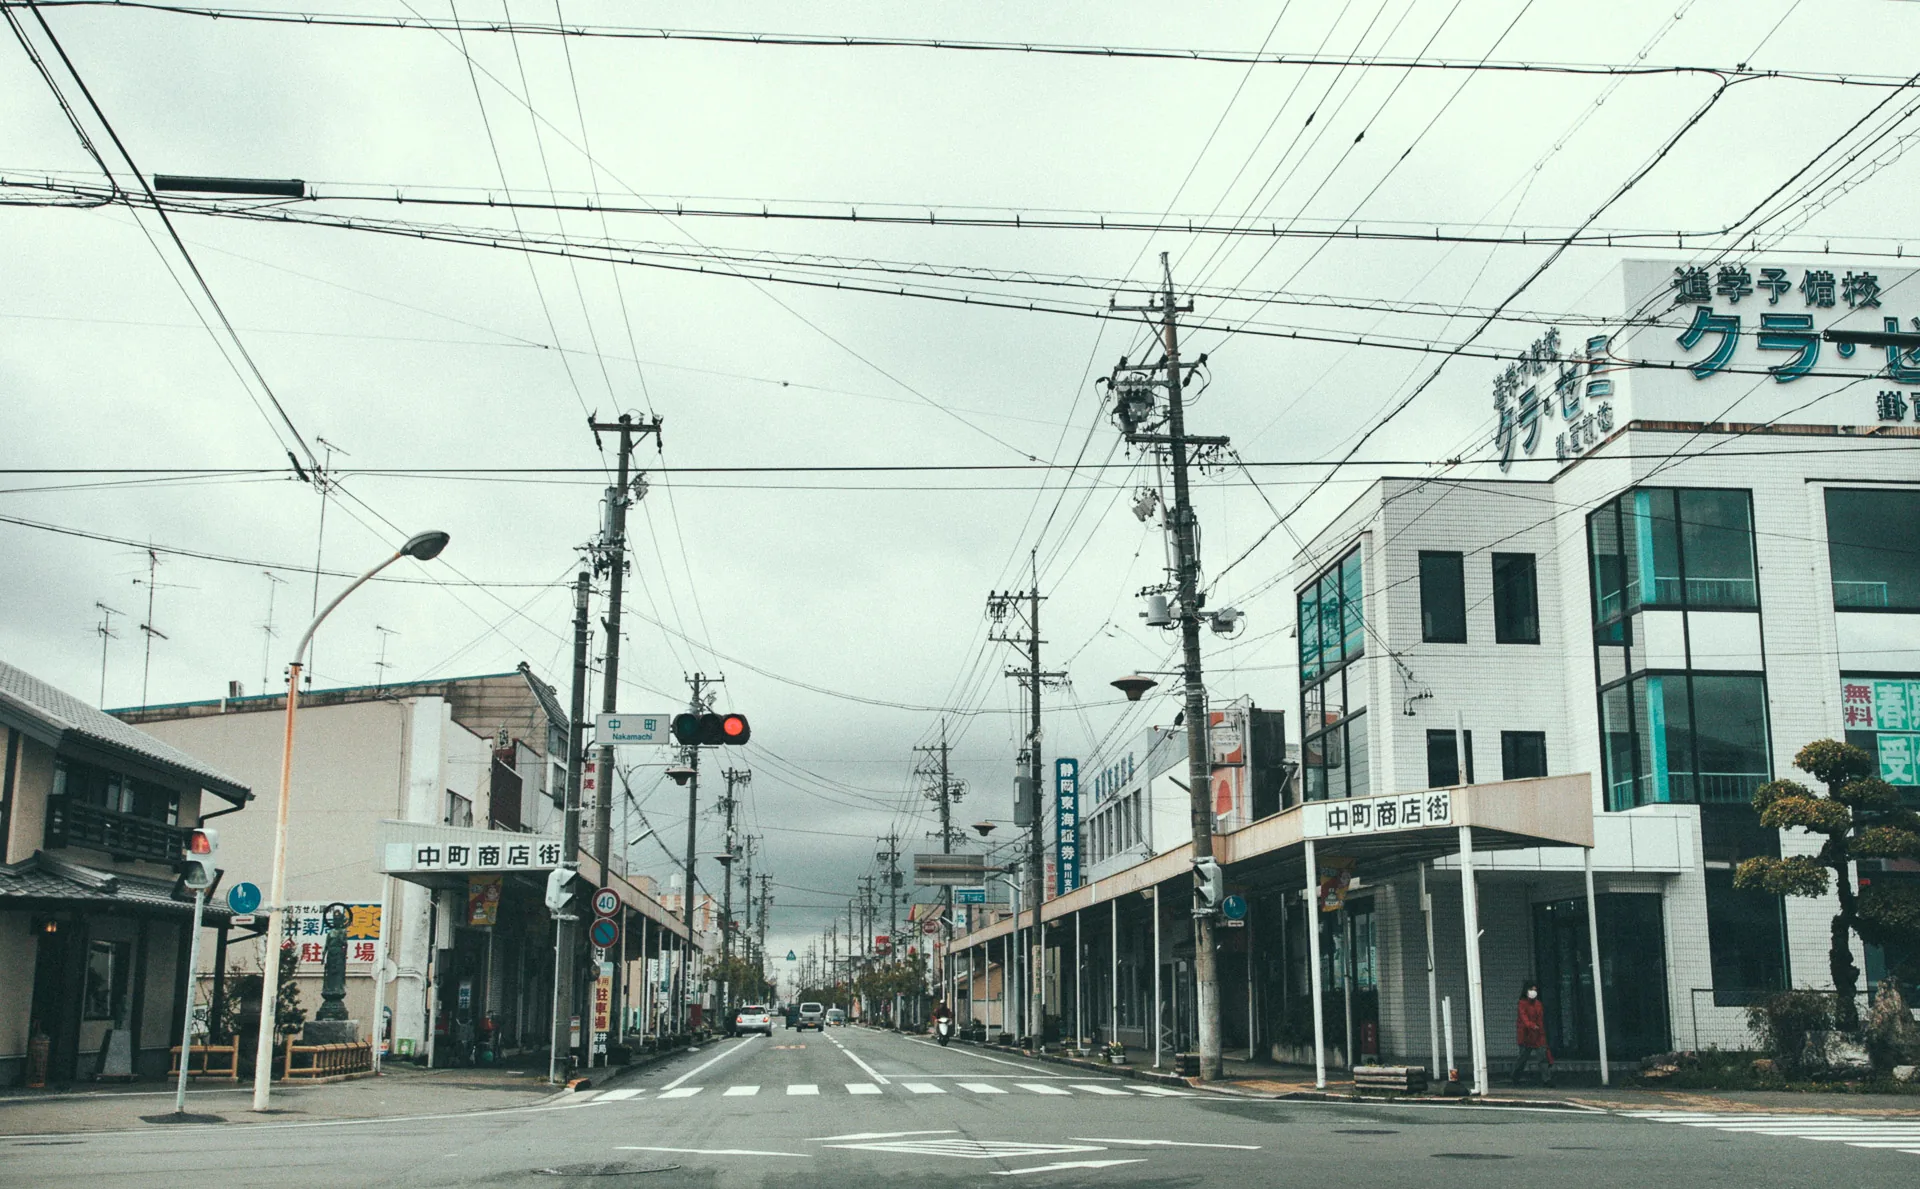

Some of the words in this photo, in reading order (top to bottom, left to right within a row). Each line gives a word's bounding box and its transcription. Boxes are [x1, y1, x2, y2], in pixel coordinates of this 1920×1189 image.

[1673, 266, 1882, 308] 進学予備校
[1844, 684, 1873, 727] 無料
[608, 718, 657, 731] 中町
[1060, 763, 1075, 860] 静岡東海証券
[1328, 794, 1449, 831] 中町商店街
[417, 844, 561, 867] 中町商店街
[598, 896, 615, 910] 40
[301, 942, 375, 962] 駐場
[595, 987, 609, 1029] 駐車場
